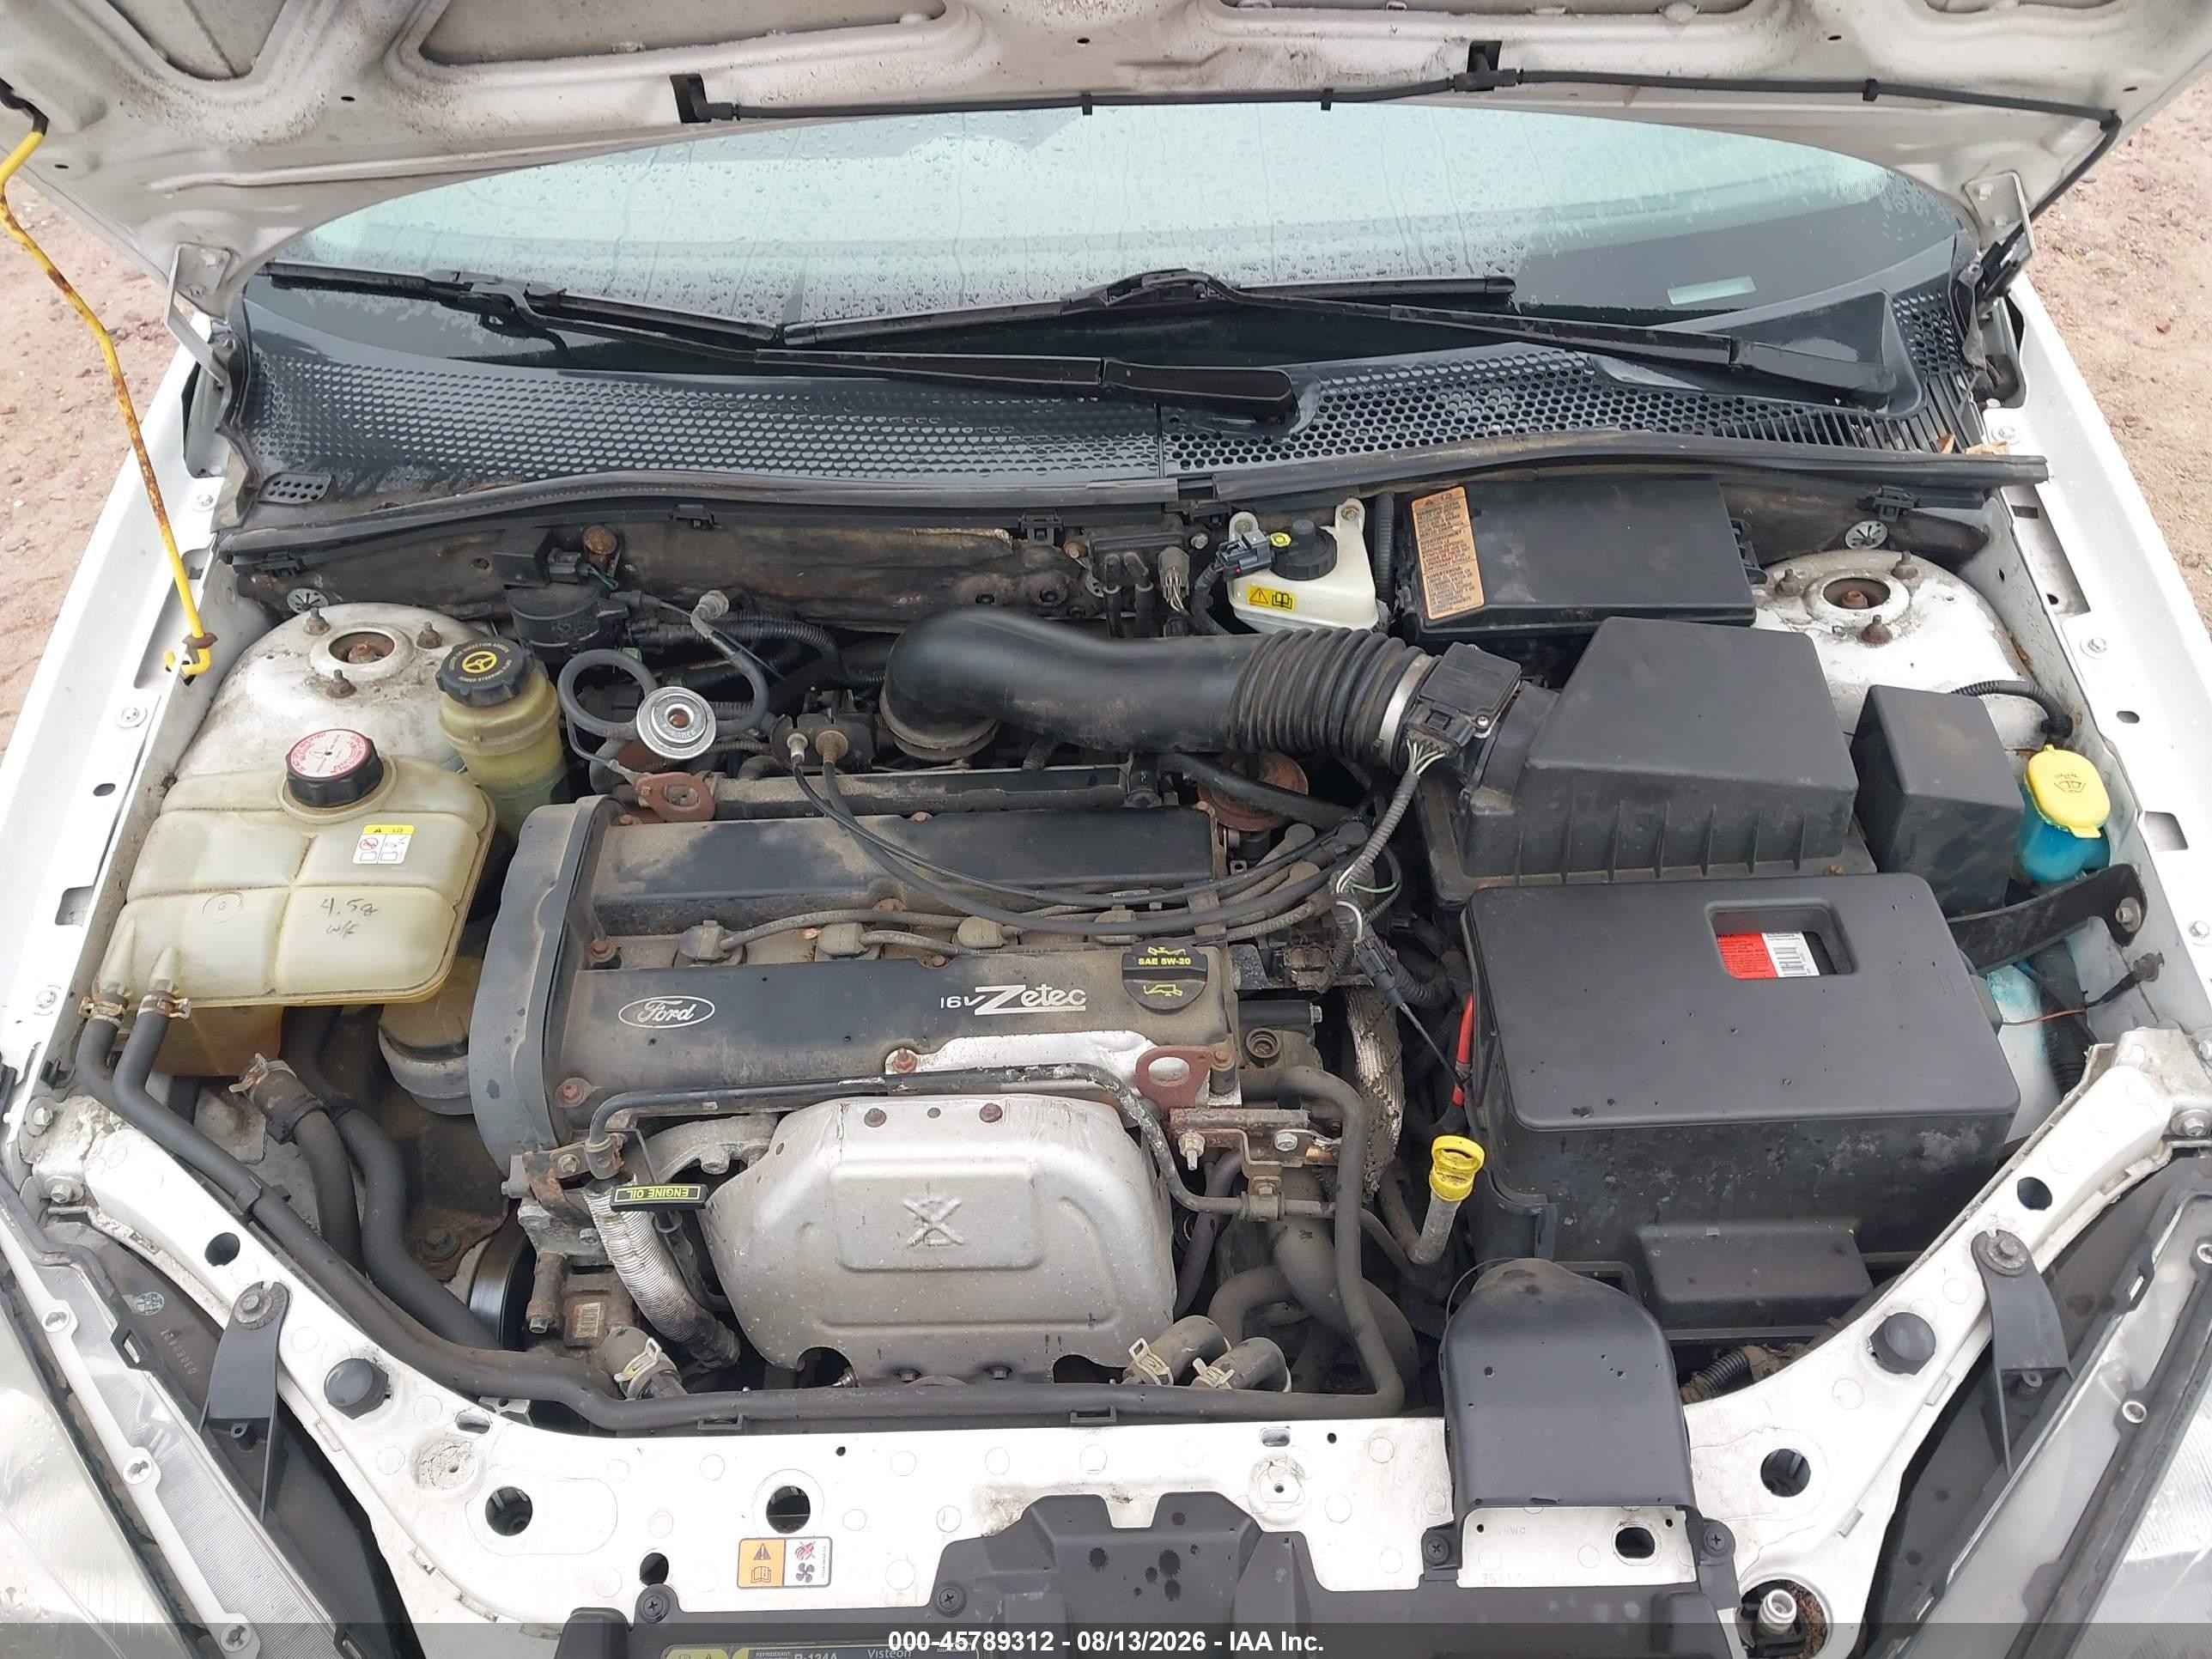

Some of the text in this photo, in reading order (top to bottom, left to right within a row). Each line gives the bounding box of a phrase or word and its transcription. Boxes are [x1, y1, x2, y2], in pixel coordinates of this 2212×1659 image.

[1138, 957, 1191, 965] SAE 5W-20
[975, 983, 1087, 1016] Zetec
[636, 1000, 697, 1023] Ford
[626, 1188, 690, 1200] ENGINE OIL
[867, 1648, 912, 1658] Visteon
